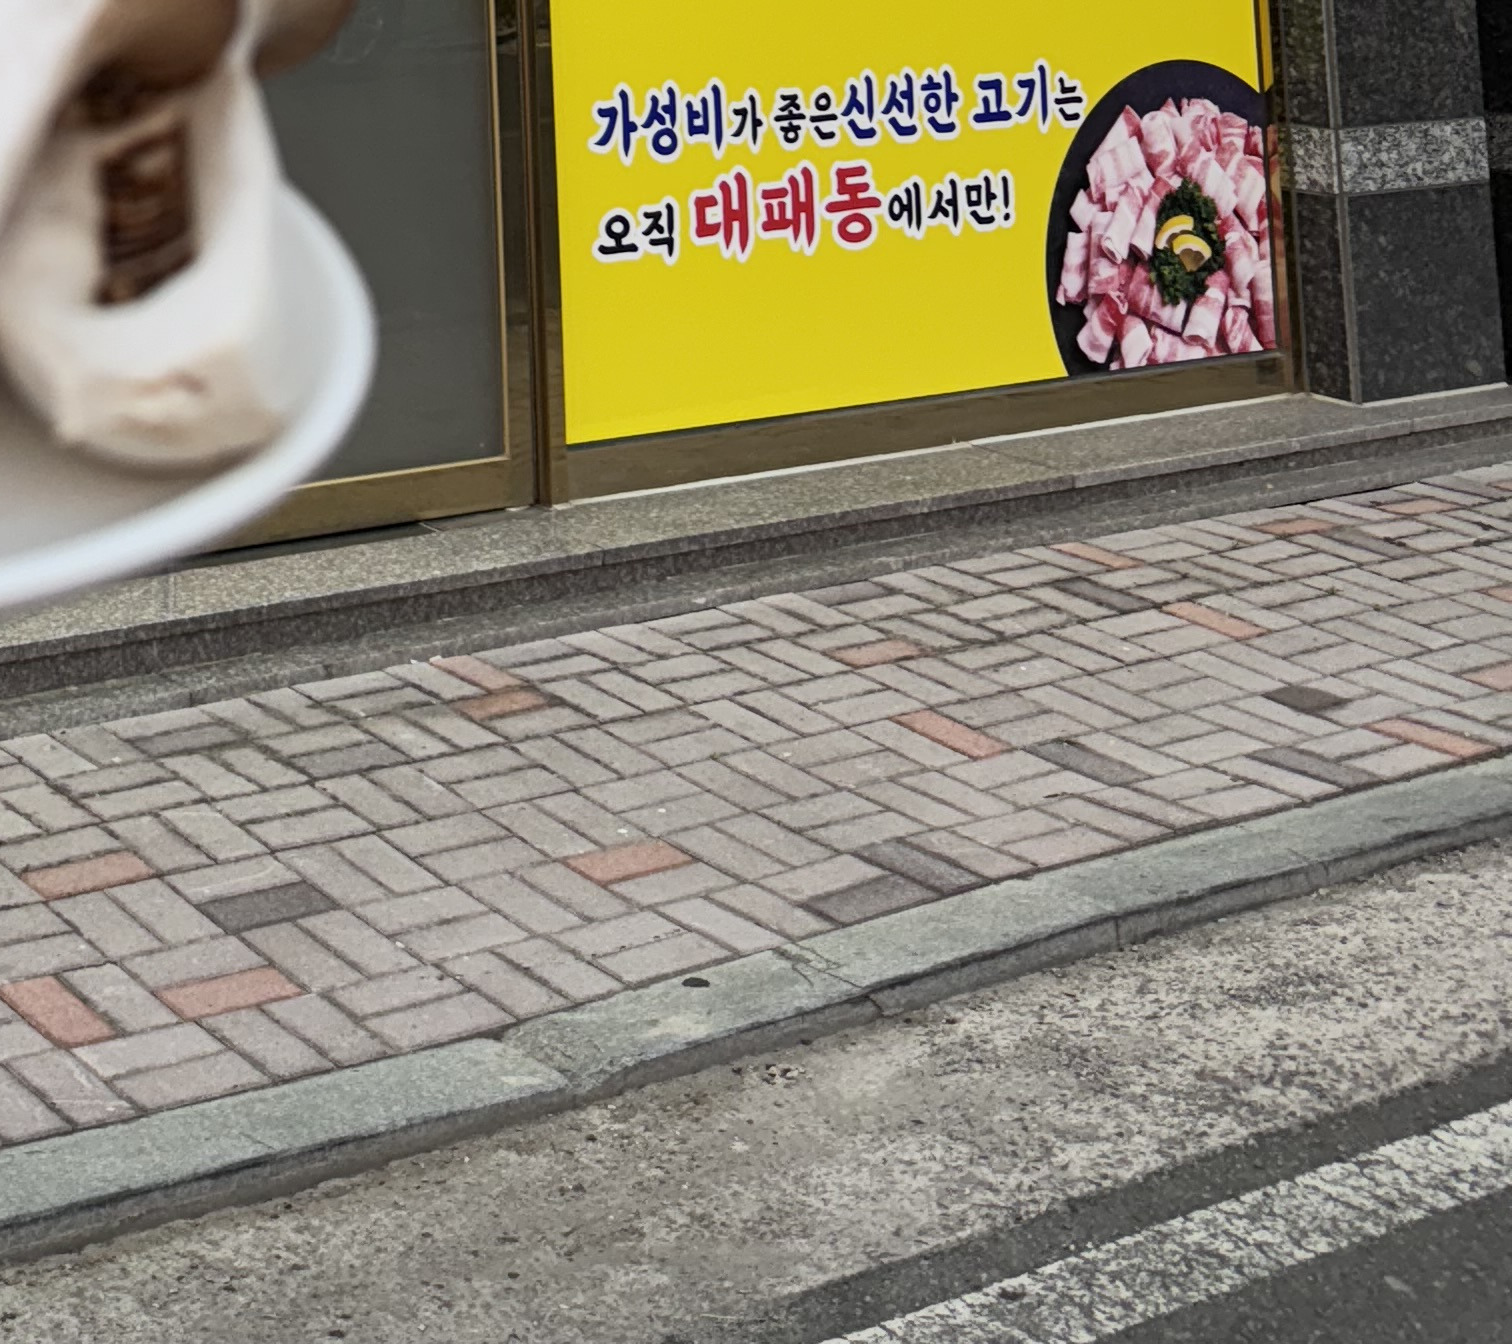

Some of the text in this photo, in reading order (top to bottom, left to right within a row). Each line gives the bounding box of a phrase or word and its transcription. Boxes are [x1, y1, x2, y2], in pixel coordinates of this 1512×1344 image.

[594, 83, 763, 158] 가성비가
[972, 64, 1085, 127] 고기는
[597, 203, 676, 259] 오직
